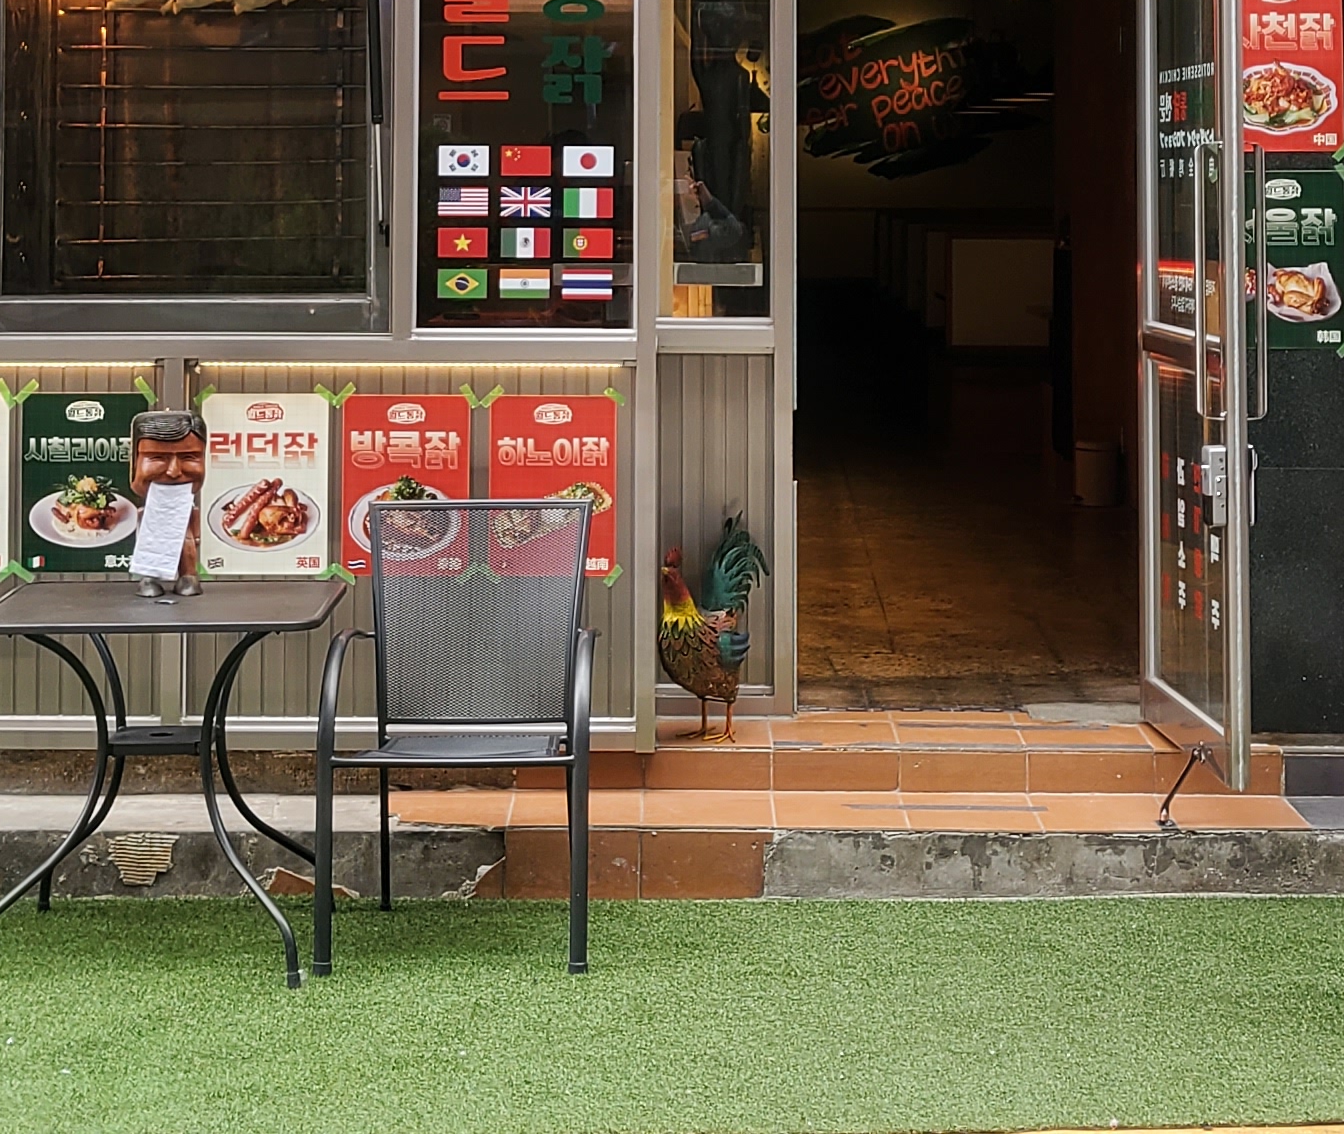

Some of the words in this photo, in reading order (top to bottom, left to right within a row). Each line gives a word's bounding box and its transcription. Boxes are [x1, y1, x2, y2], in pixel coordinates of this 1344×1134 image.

[1313, 132, 1338, 147] 中国
[209, 431, 319, 469] 런던잙
[350, 430, 461, 470] 방콕잙
[497, 436, 610, 467] 하노이잙
[296, 556, 321, 569] 英国
